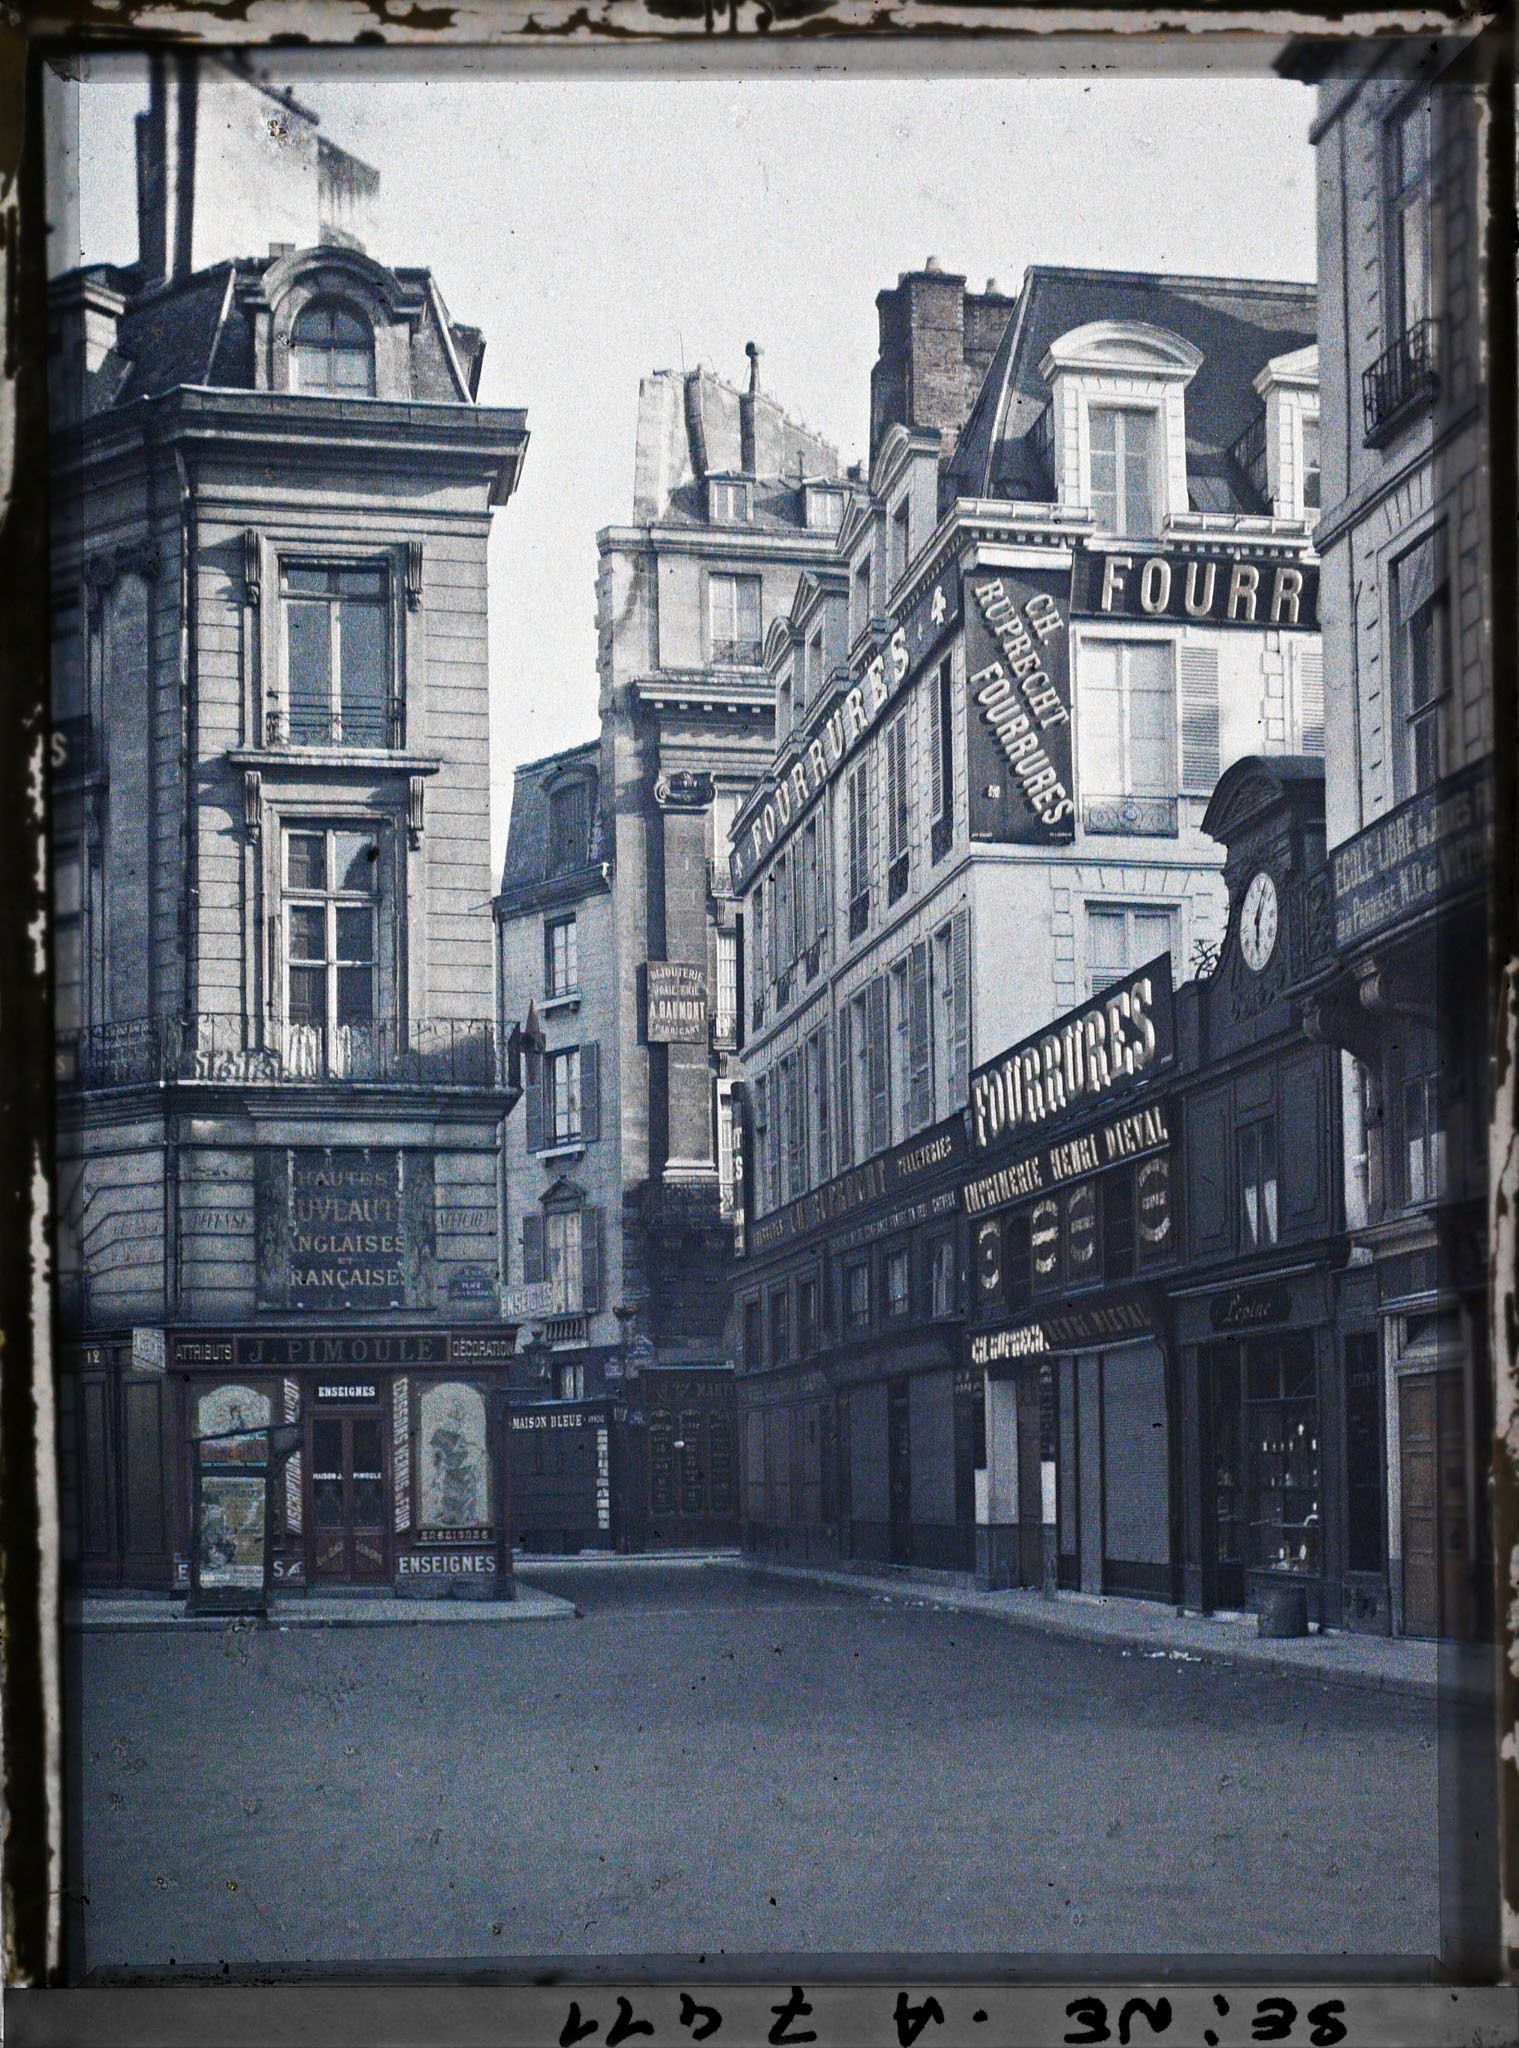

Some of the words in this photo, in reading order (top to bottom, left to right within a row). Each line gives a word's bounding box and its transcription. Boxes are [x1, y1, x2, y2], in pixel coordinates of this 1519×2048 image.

[975, 578, 1070, 731] RUPRECHT
[751, 626, 910, 859] FOURRURES
[969, 661, 1075, 826] FOURRURES
[651, 966, 704, 982] BIJOUTERIE
[971, 977, 1156, 1147] FOURRURES
[1050, 1132, 1100, 1181] HENRI
[176, 1344, 233, 1361] ATTRIBUTS
[287, 1338, 433, 1362] PIMOULE
[318, 1386, 376, 1398] ENSEIGNES
[512, 1417, 547, 1430] MAISON
[550, 1414, 583, 1428] BLEUE
[420, 1530, 489, 1541] ENSEIGNES
[398, 1556, 497, 1574] ENSEIGNES
